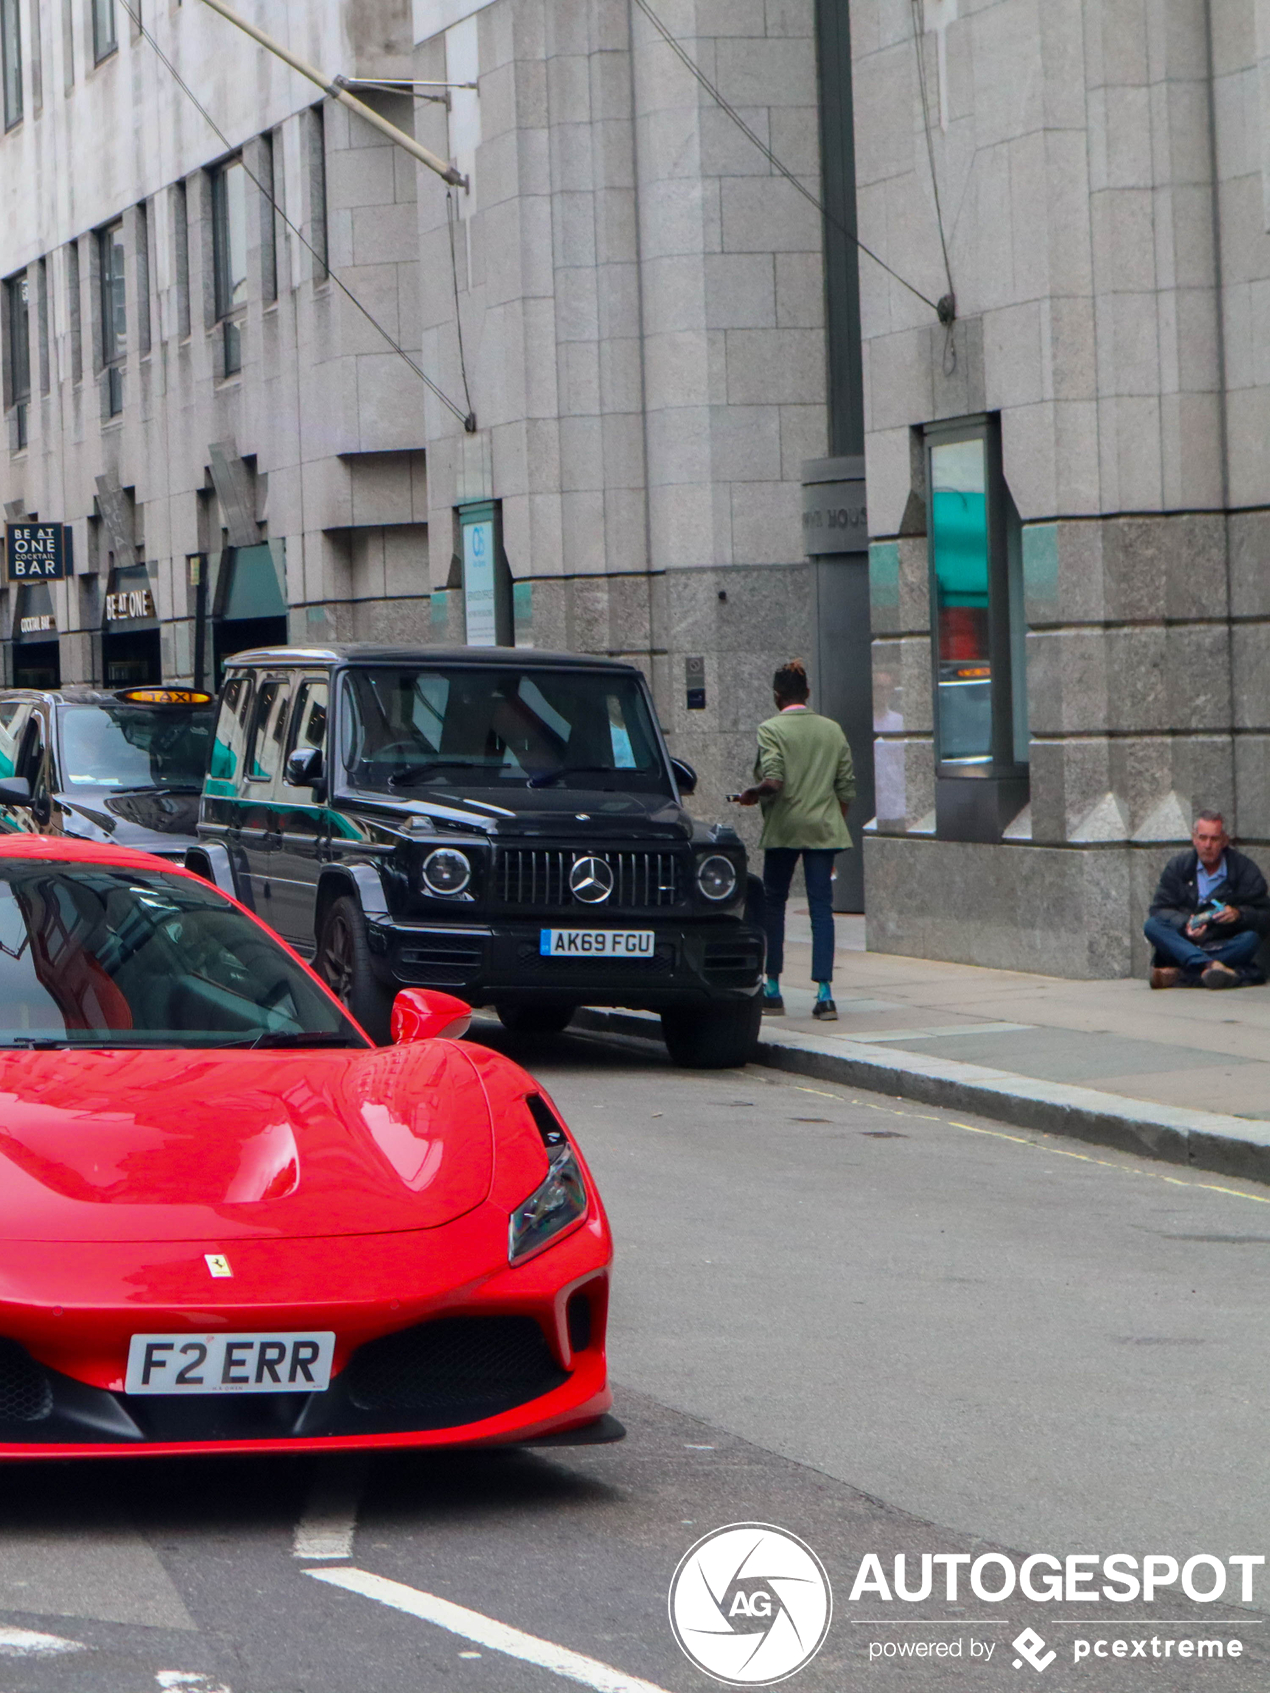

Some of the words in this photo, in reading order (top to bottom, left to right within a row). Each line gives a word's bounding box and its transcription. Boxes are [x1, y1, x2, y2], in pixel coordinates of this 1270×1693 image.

[14, 529, 31, 540] BE
[37, 528, 55, 539] AT
[15, 540, 55, 553] ONE
[15, 553, 55, 561] COCKTAIL
[15, 561, 56, 575] BAR
[106, 594, 117, 621] BE
[118, 592, 128, 613] AT
[129, 589, 148, 618] ONE
[21, 616, 41, 633] COCKTAIL
[41, 615, 50, 630] BAR
[147, 691, 193, 703] TAXI
[554, 932, 606, 952] AK69
[612, 933, 651, 953] FGU
[141, 1342, 207, 1385] F2
[221, 1340, 320, 1384] ERR
